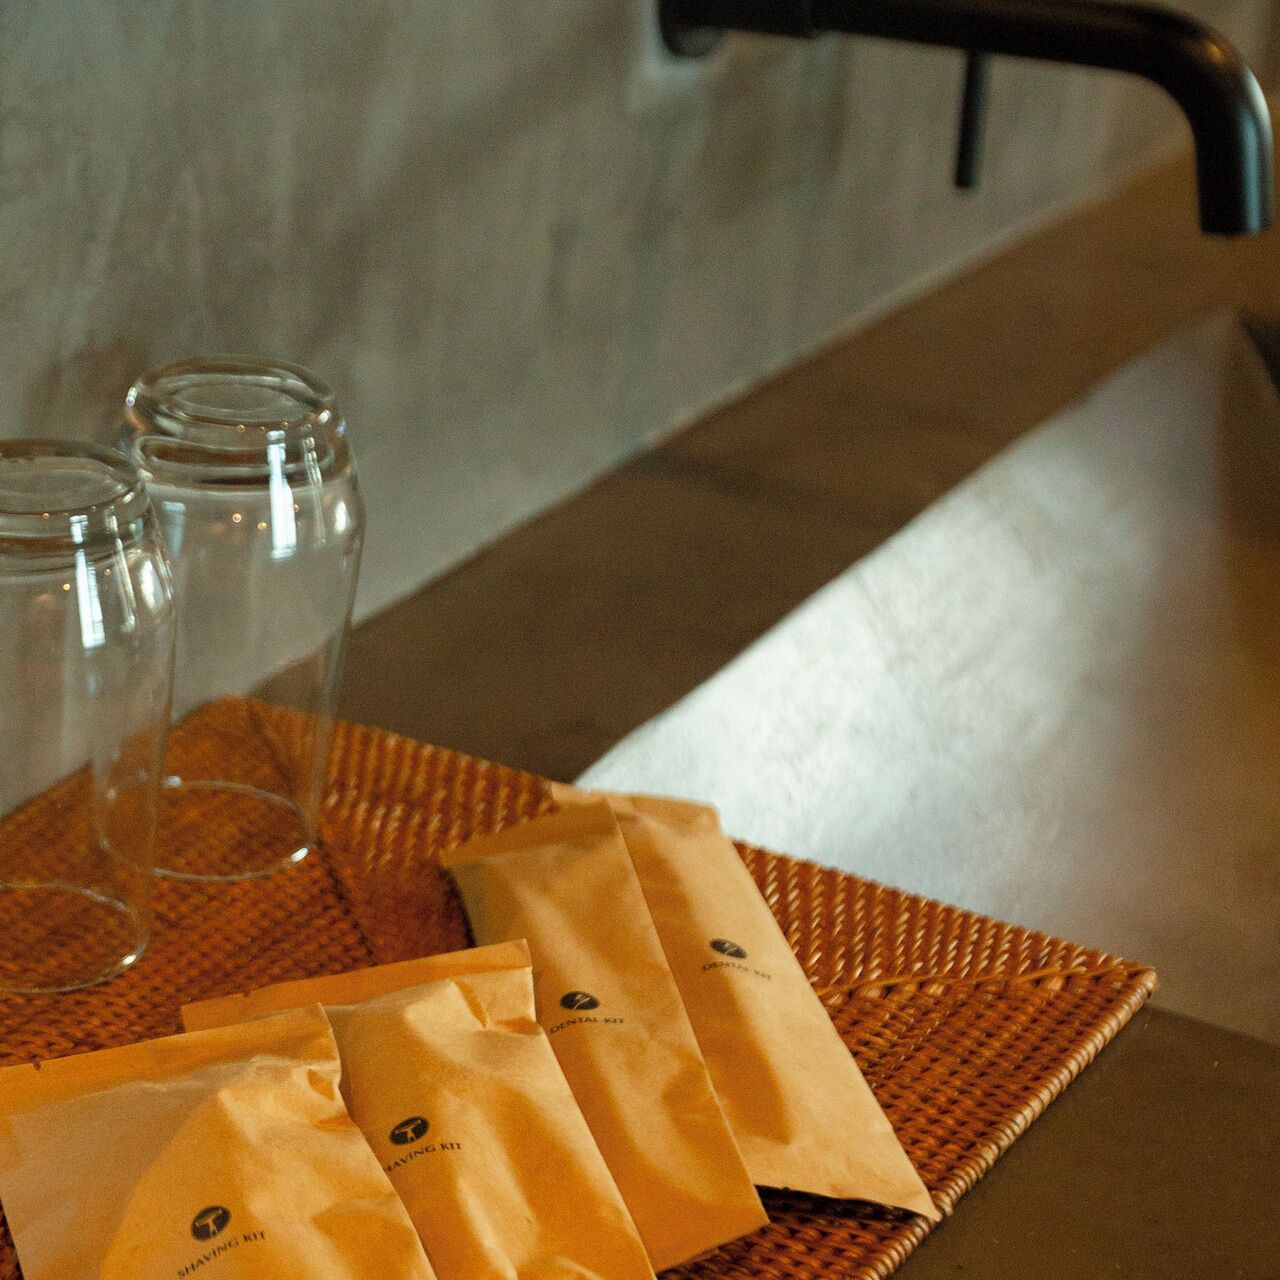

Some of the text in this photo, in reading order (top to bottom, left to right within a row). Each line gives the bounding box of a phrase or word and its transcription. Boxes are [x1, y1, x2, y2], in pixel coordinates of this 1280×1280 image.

[549, 1016, 624, 1034] DENTAL KIT
[384, 1141, 462, 1172] HAVING KIT
[177, 1230, 265, 1278] SHAVING KIT
